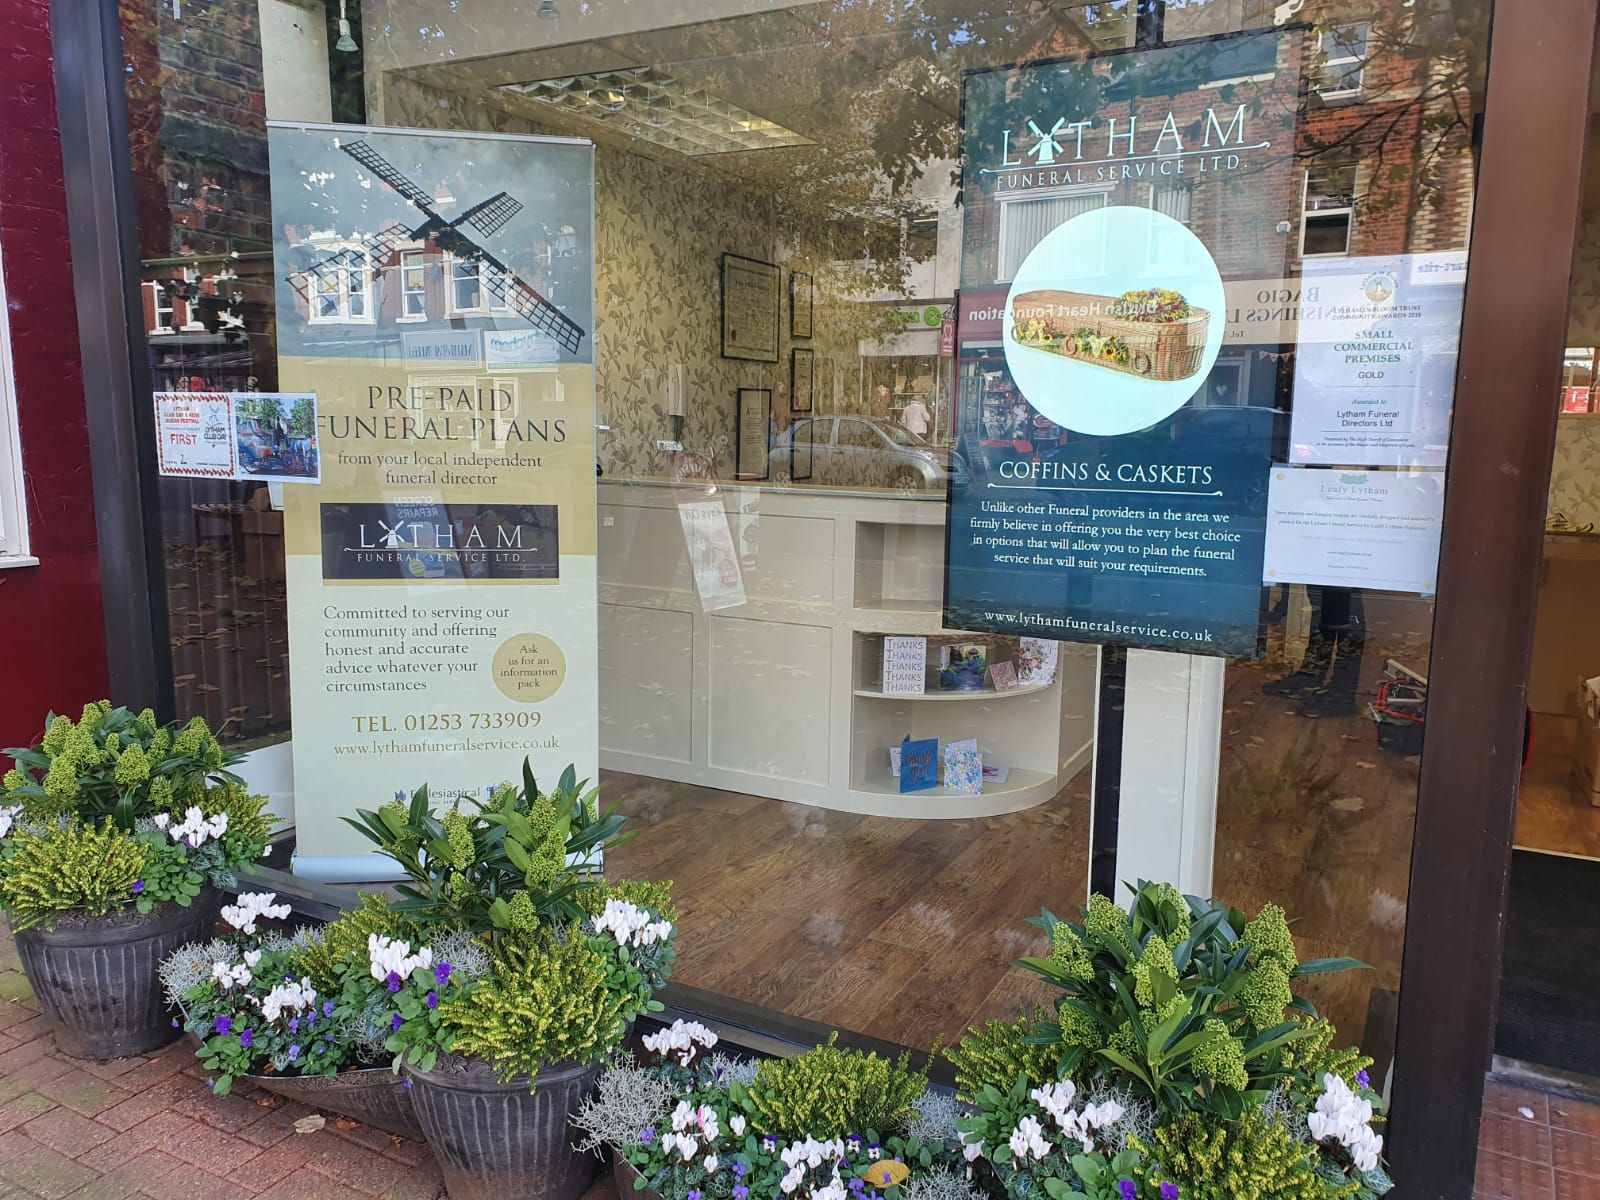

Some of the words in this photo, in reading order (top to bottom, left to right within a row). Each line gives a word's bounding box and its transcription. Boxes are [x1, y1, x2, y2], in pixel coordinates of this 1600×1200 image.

[996, 170, 1084, 189] FUNERAL
[1096, 159, 1184, 181] SERVICE
[1199, 155, 1248, 172] LTD.
[1355, 330, 1394, 340] SMALL
[1334, 342, 1414, 352] COMMERCIAL
[1344, 354, 1400, 364] PREMISES
[368, 386, 512, 412] PRE-PAID
[1336, 410, 1366, 419] Lytham
[472, 417, 566, 442] PLANS
[170, 434, 197, 445] FIRST
[338, 450, 372, 464] from
[377, 454, 408, 468] your
[414, 452, 448, 466] local
[452, 452, 542, 470] independent
[386, 470, 436, 484] funeral
[440, 471, 498, 485] director
[999, 462, 1088, 481] COFFINS
[1095, 464, 1112, 481] &
[1117, 464, 1213, 485] CASKETS
[1320, 484, 1348, 496] Leafy
[1352, 486, 1388, 496] Lytham
[981, 501, 1015, 514] Unlike
[1017, 503, 1044, 515] other
[1048, 504, 1089, 517] Funeral
[1092, 506, 1145, 521] providers
[1148, 508, 1160, 520] in
[1163, 508, 1181, 521] the
[1184, 512, 1208, 522] area
[1212, 514, 1230, 523] we
[970, 516, 1000, 532] firmly
[1003, 518, 1038, 532] believe
[1041, 520, 1052, 532] in
[1054, 520, 1098, 536] offering
[1101, 525, 1122, 538] you
[1125, 524, 1143, 537] the
[1146, 528, 1171, 542] very
[1174, 527, 1198, 540] best
[1202, 529, 1241, 542] choice
[972, 534, 982, 544] in
[985, 535, 1024, 548] options
[1026, 536, 1047, 548] that
[1050, 536, 1069, 550] will
[1072, 538, 1100, 551] allow
[1104, 542, 1125, 554] you
[1128, 542, 1140, 554] to
[1143, 542, 1168, 558] plan
[1171, 544, 1190, 556] the
[1194, 546, 1235, 560] funeral
[357, 553, 423, 562] FUNERAL
[429, 553, 488, 562] SERVICE
[496, 553, 526, 562] LTD.
[994, 552, 1029, 564] service
[1032, 554, 1054, 566] that
[1056, 555, 1076, 567] will
[1078, 556, 1098, 569] suit
[1100, 560, 1126, 573] your
[1129, 562, 1207, 578] requirements.
[324, 606, 408, 620] Committed
[412, 607, 427, 619] to
[431, 607, 482, 620] serving
[486, 608, 510, 618] our
[324, 625, 408, 640] community
[411, 624, 438, 637] and
[442, 622, 497, 638] offering
[984, 610, 1213, 642] www.lythamfuneralservice.co.uk
[325, 642, 372, 656] honest
[378, 642, 405, 656] and
[409, 643, 470, 655] accurate
[519, 644, 538, 654] Ask
[886, 638, 924, 650] THANKS
[508, 657, 519, 666] us
[520, 656, 534, 666] for
[537, 657, 550, 666] an
[886, 650, 922, 660] THANKS
[326, 660, 372, 674] advice
[376, 660, 443, 674] whatever
[447, 662, 479, 676] your
[886, 660, 922, 671] THANKS
[500, 667, 558, 678] information
[886, 670, 922, 682] THANKS
[326, 679, 427, 692] circumstances
[518, 678, 540, 690] pack
[885, 681, 922, 692] THANKS
[352, 716, 397, 732] TEL.
[404, 713, 462, 732] 01253
[469, 711, 542, 730] 733909
[334, 736, 560, 758] www.lythamfuneralservice.co.uk
[410, 787, 480, 799] Elesiastical
